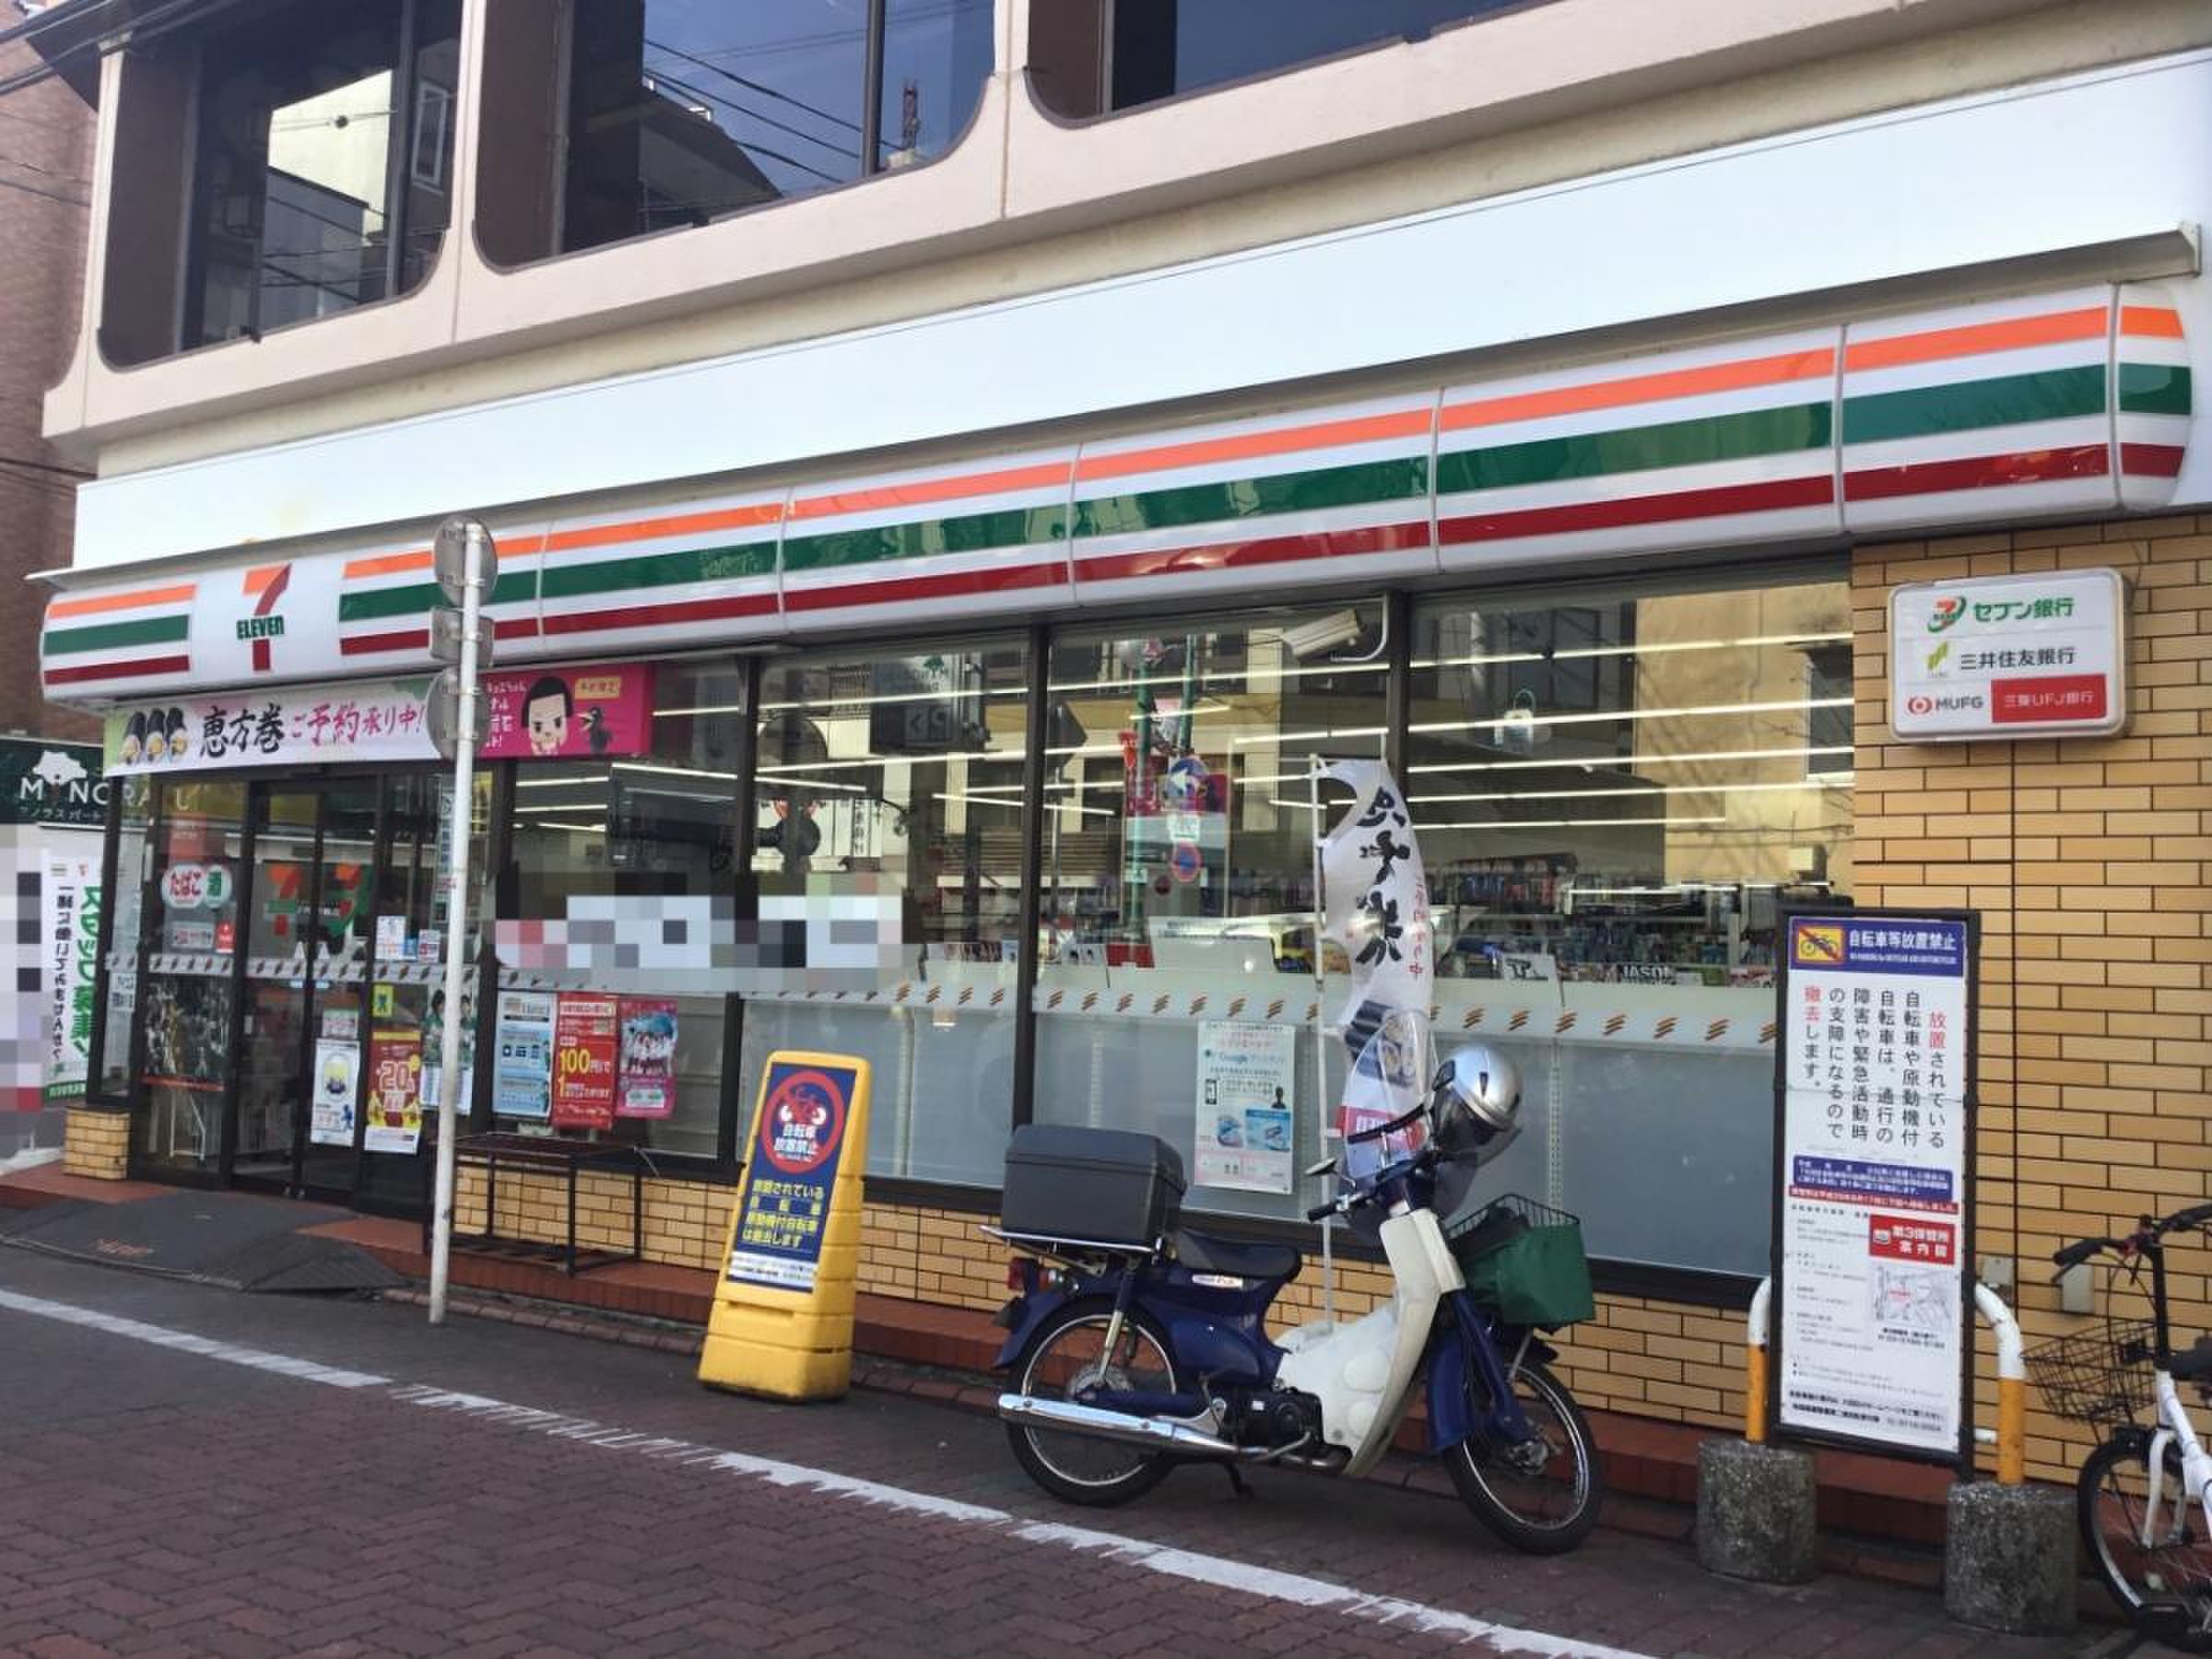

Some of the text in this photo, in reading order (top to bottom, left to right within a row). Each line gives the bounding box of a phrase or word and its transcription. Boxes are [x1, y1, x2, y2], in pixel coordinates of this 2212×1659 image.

[1974, 597, 2074, 624] セブン銀行
[1960, 647, 2076, 671] 三井住友銀行
[1936, 696, 1983, 712] MUFG
[1850, 929, 1957, 950] 自転車等放置禁止
[1828, 988, 1845, 1138] の支障になるので
[1852, 988, 1870, 1142] 障害や緊急活動時
[1902, 991, 1922, 1147] 自転車や原動機付
[1930, 1011, 1947, 1148] 放置されている
